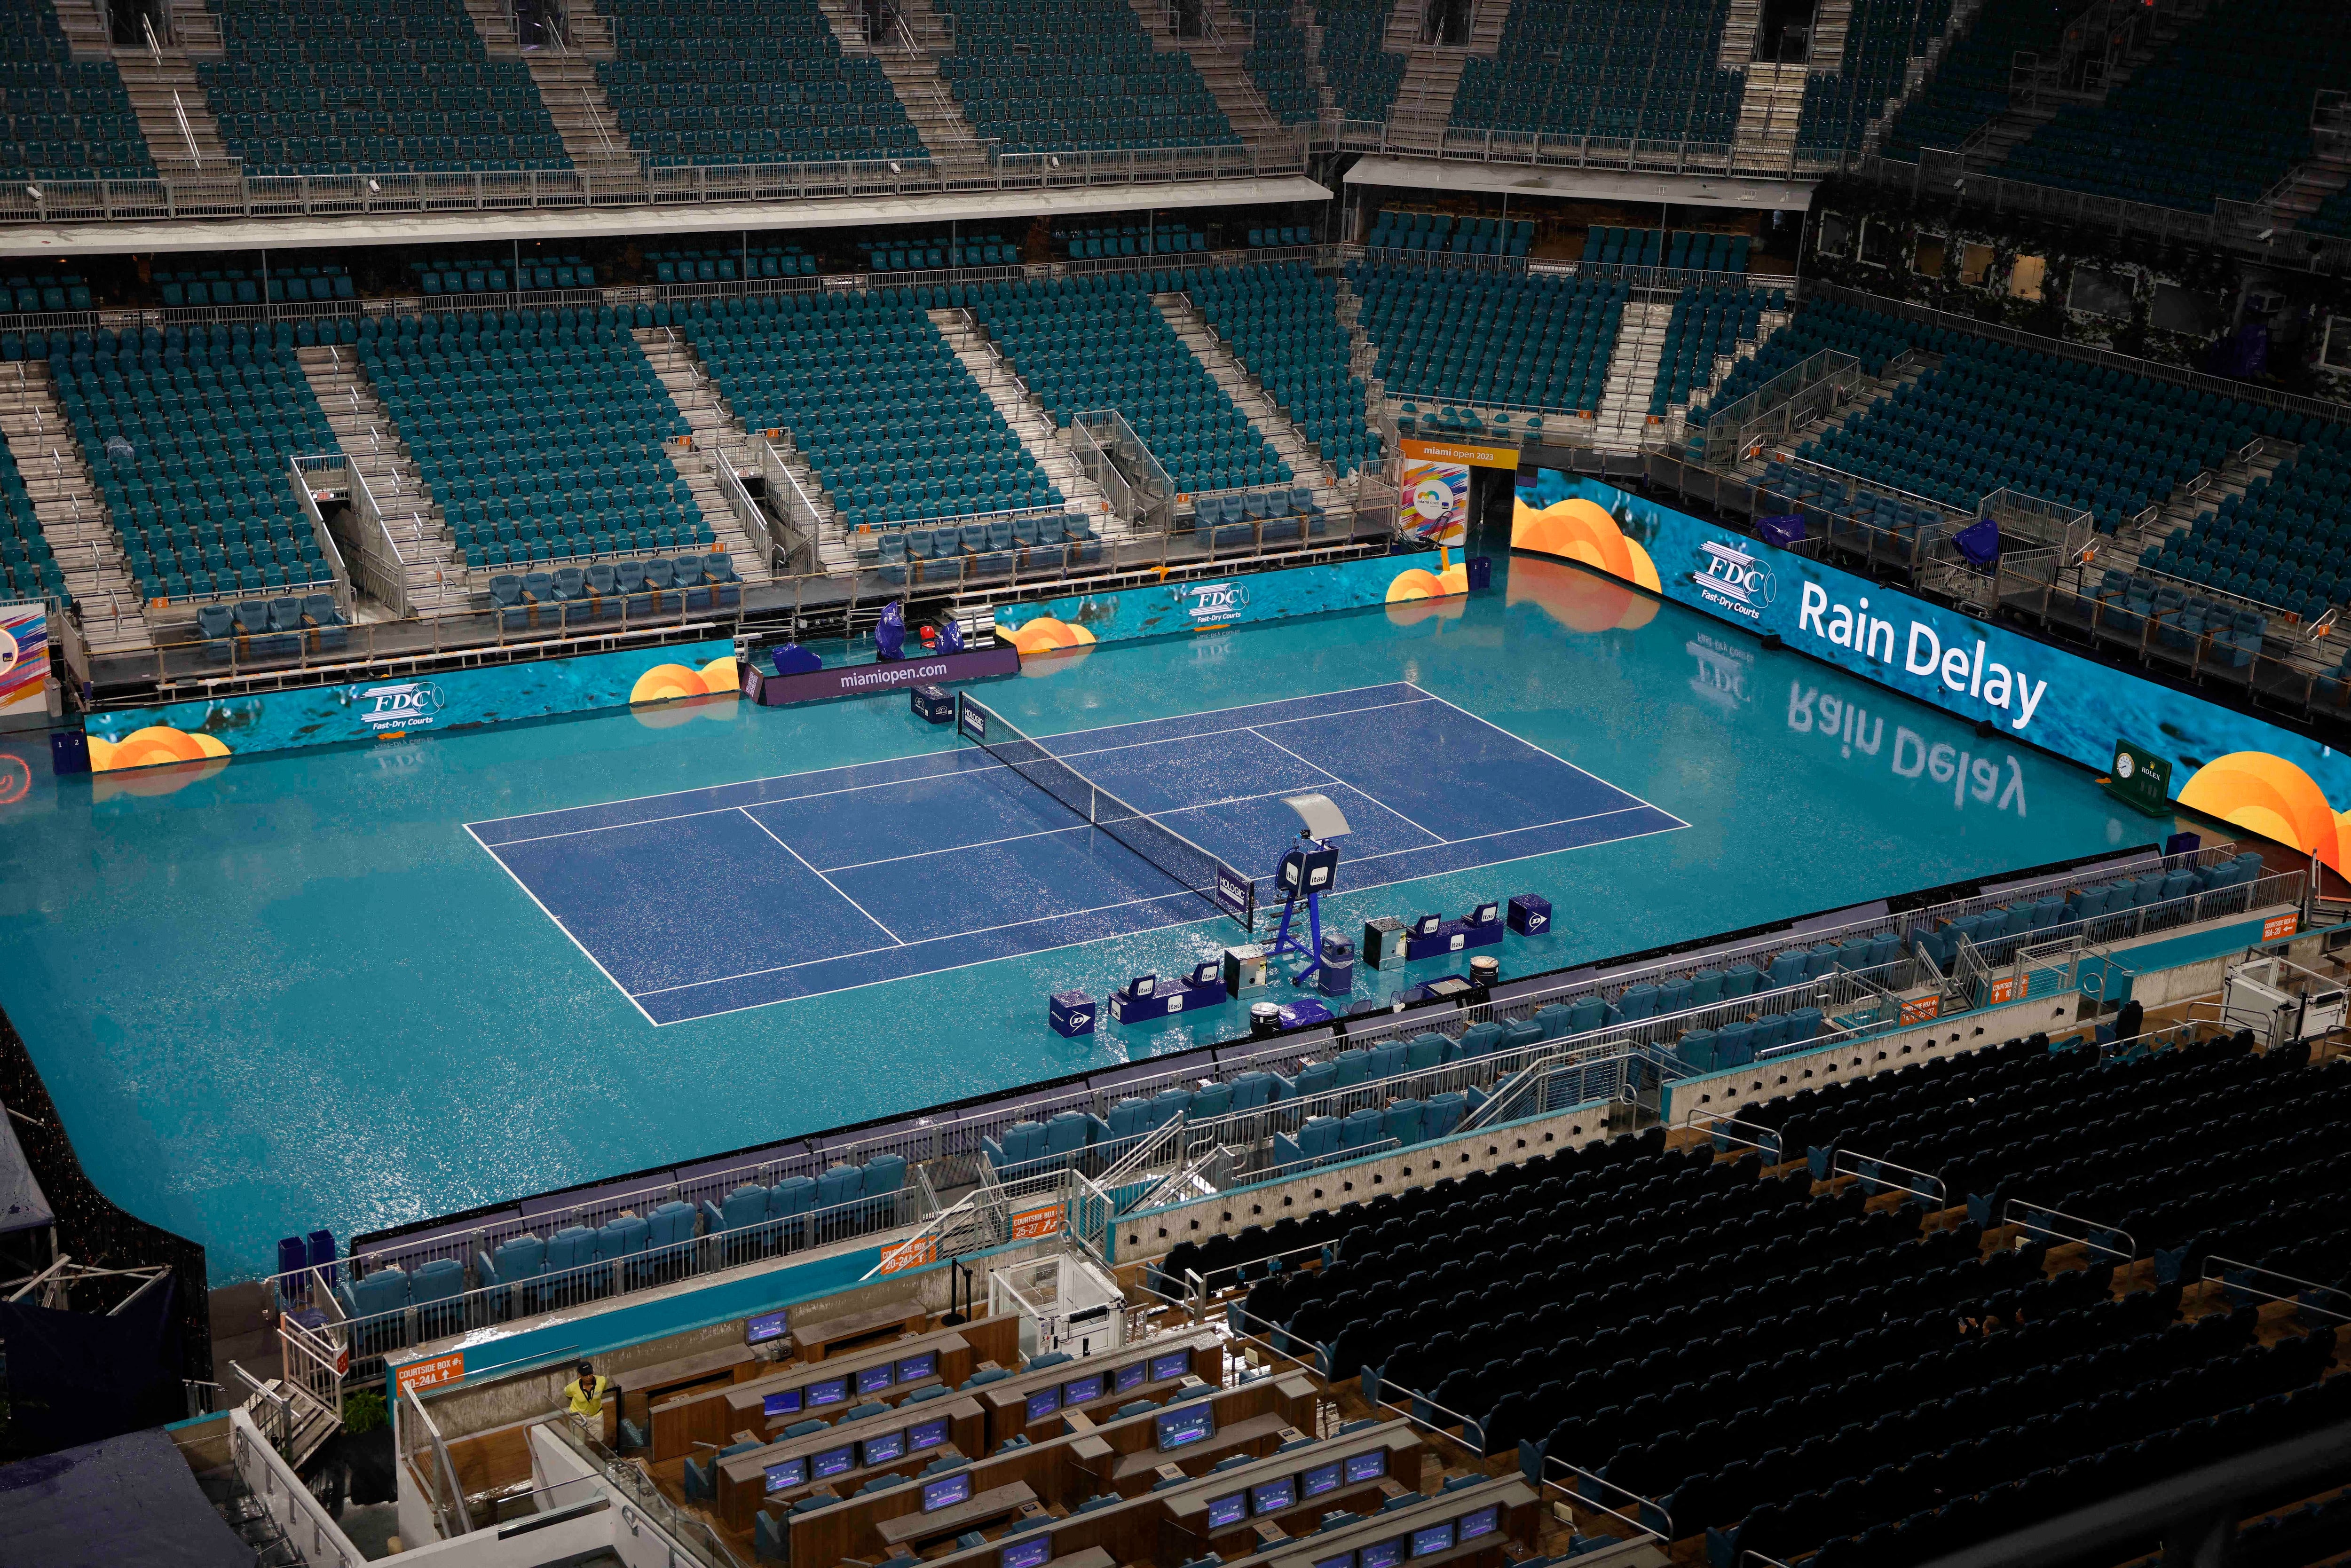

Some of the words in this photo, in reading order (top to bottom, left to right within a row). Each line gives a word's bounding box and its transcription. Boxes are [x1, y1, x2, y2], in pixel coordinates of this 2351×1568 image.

[1424, 447, 1452, 456] miami
[1705, 555, 1764, 592] FDC
[1198, 589, 1239, 608] FDC
[1701, 589, 1734, 610] Fast-Dry
[1734, 602, 1760, 619] Courts
[1197, 615, 1222, 623] Fast-Dry
[1799, 580, 1895, 664] Rain
[1905, 620, 2048, 729] Delay
[841, 664, 947, 688] miamiopen.com
[372, 690, 431, 712] FDC
[373, 720, 407, 730] Fast-Dry
[408, 717, 434, 726] Courts
[964, 707, 984, 726] HOLOGIC
[2141, 766, 2161, 781] ROLEX
[1287, 871, 1296, 882] Itaú
[1311, 875, 1325, 883] Itaú
[1220, 876, 1245, 899] HOLOGIC
[2264, 919, 2284, 929] COURTSIDE
[2264, 927, 2281, 938] 16A-20
[1051, 1010, 1064, 1022] DUNLOP
[1112, 1008, 1120, 1018] Itaú
[1014, 1213, 1043, 1226] COURTSIDE
[1044, 1210, 1055, 1219] BOX
[1016, 1223, 1038, 1237] 25-27
[914, 1242, 926, 1251] BOX
[399, 1363, 436, 1379] COURTSIDE
[437, 1359, 451, 1370] BOX
[404, 1373, 437, 1387] 0-24A
